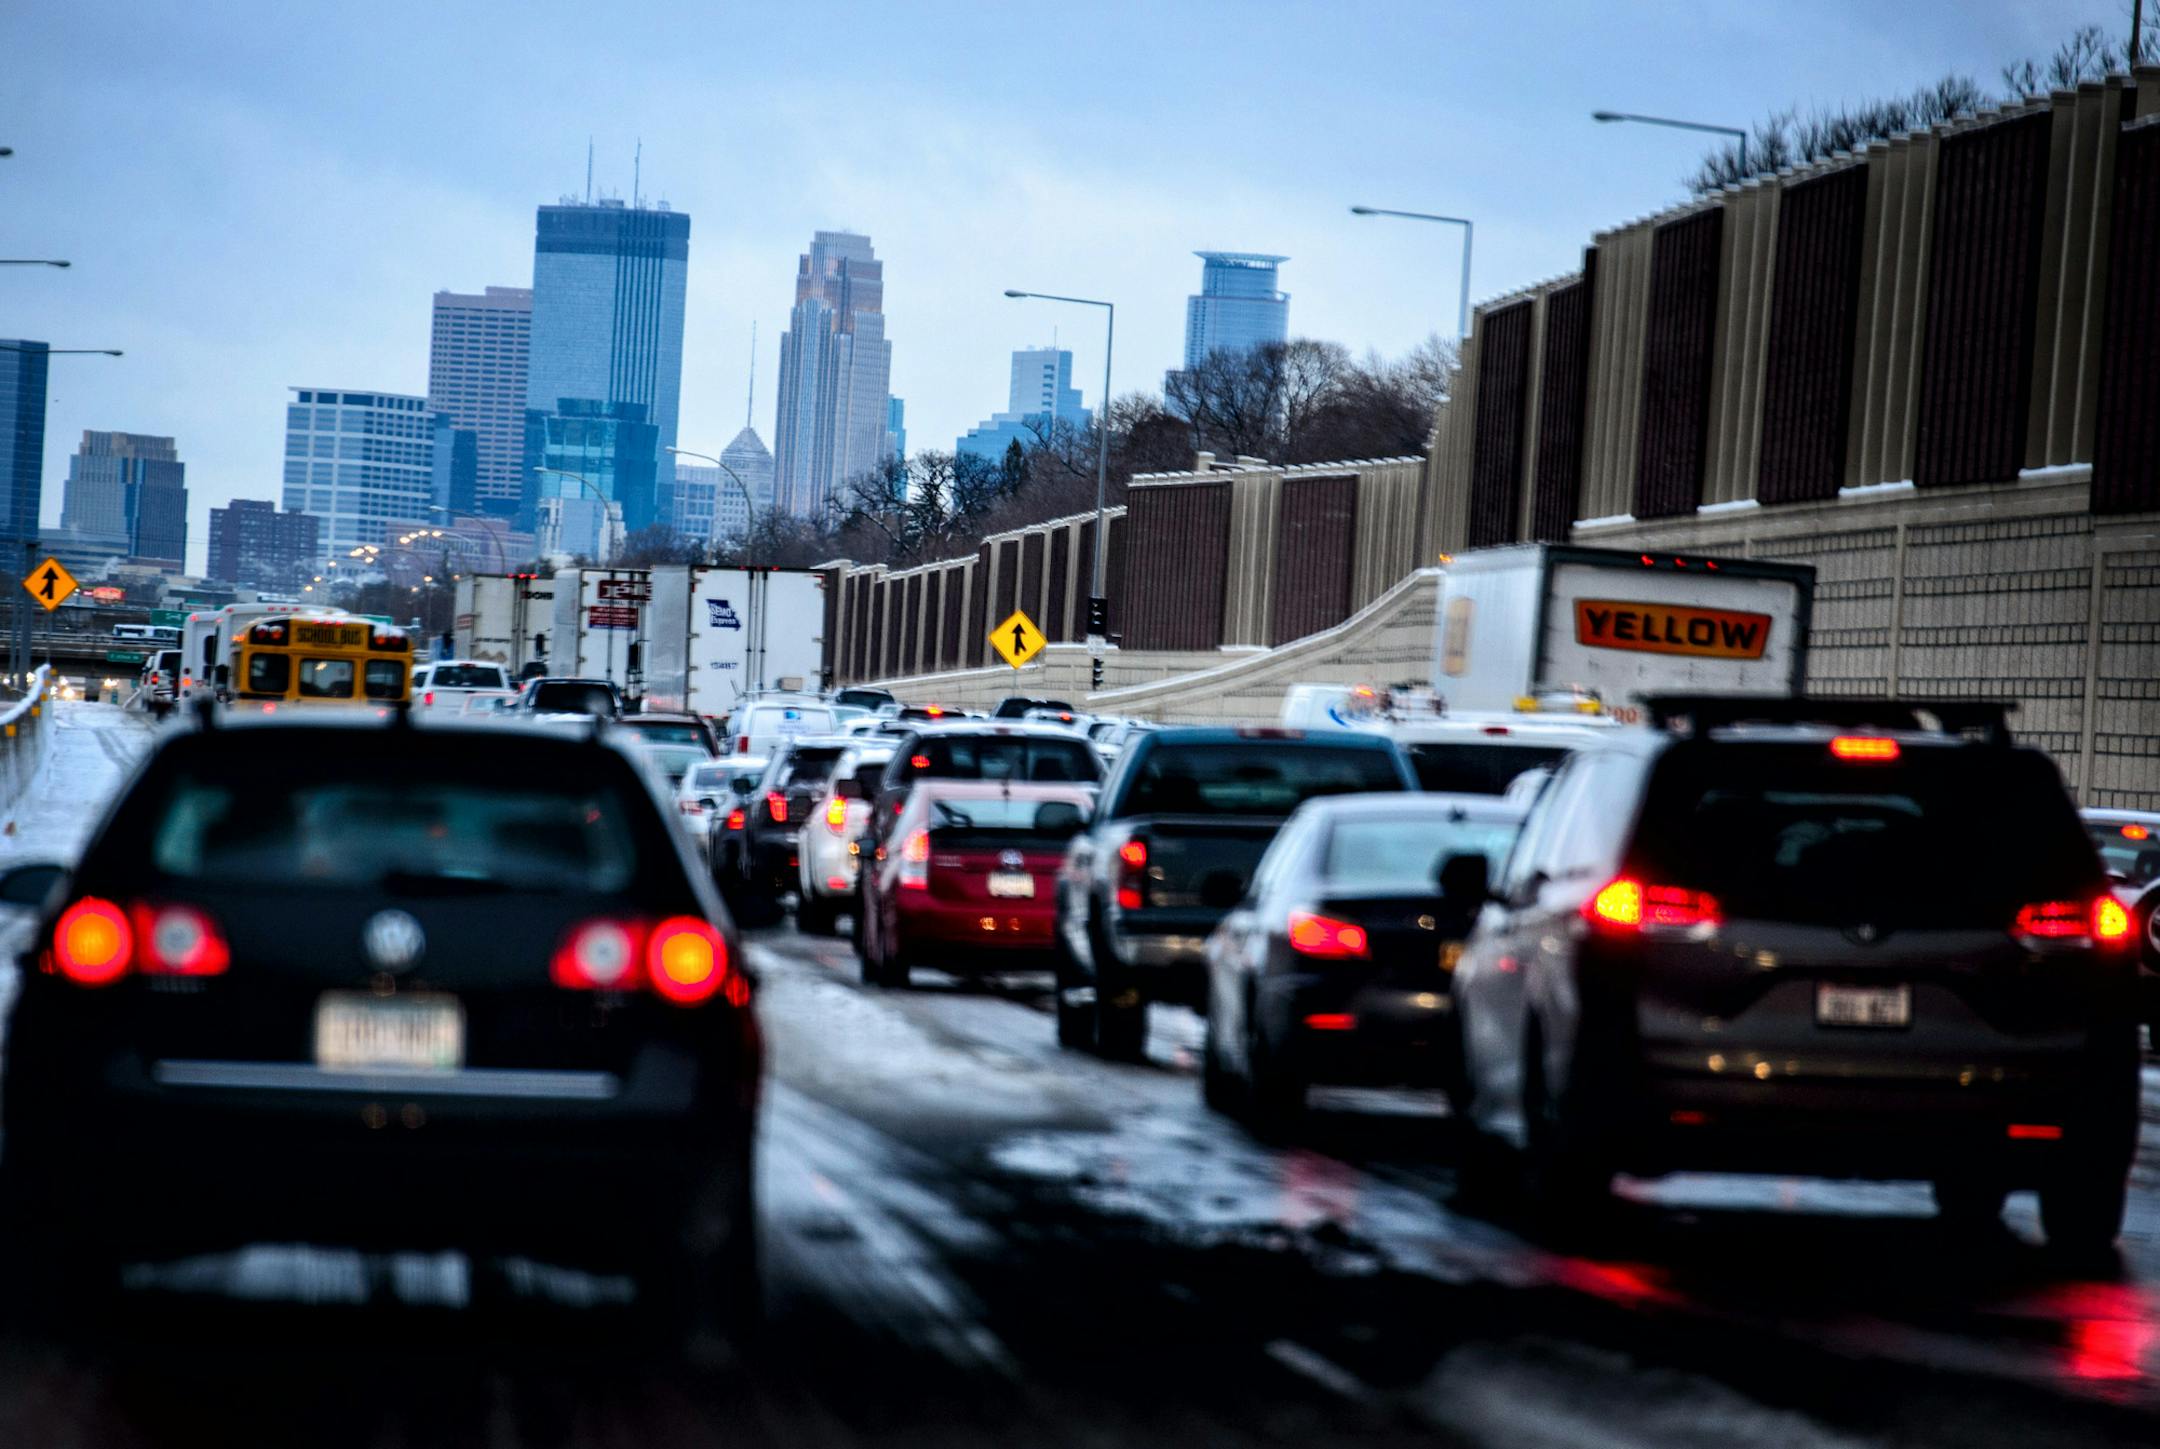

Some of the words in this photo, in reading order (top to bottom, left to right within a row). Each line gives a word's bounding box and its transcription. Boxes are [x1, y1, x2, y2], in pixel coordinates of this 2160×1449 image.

[298, 627, 335, 643] SCHOOL
[341, 628, 362, 645] BUS
[1585, 608, 1758, 649] YELLOW
